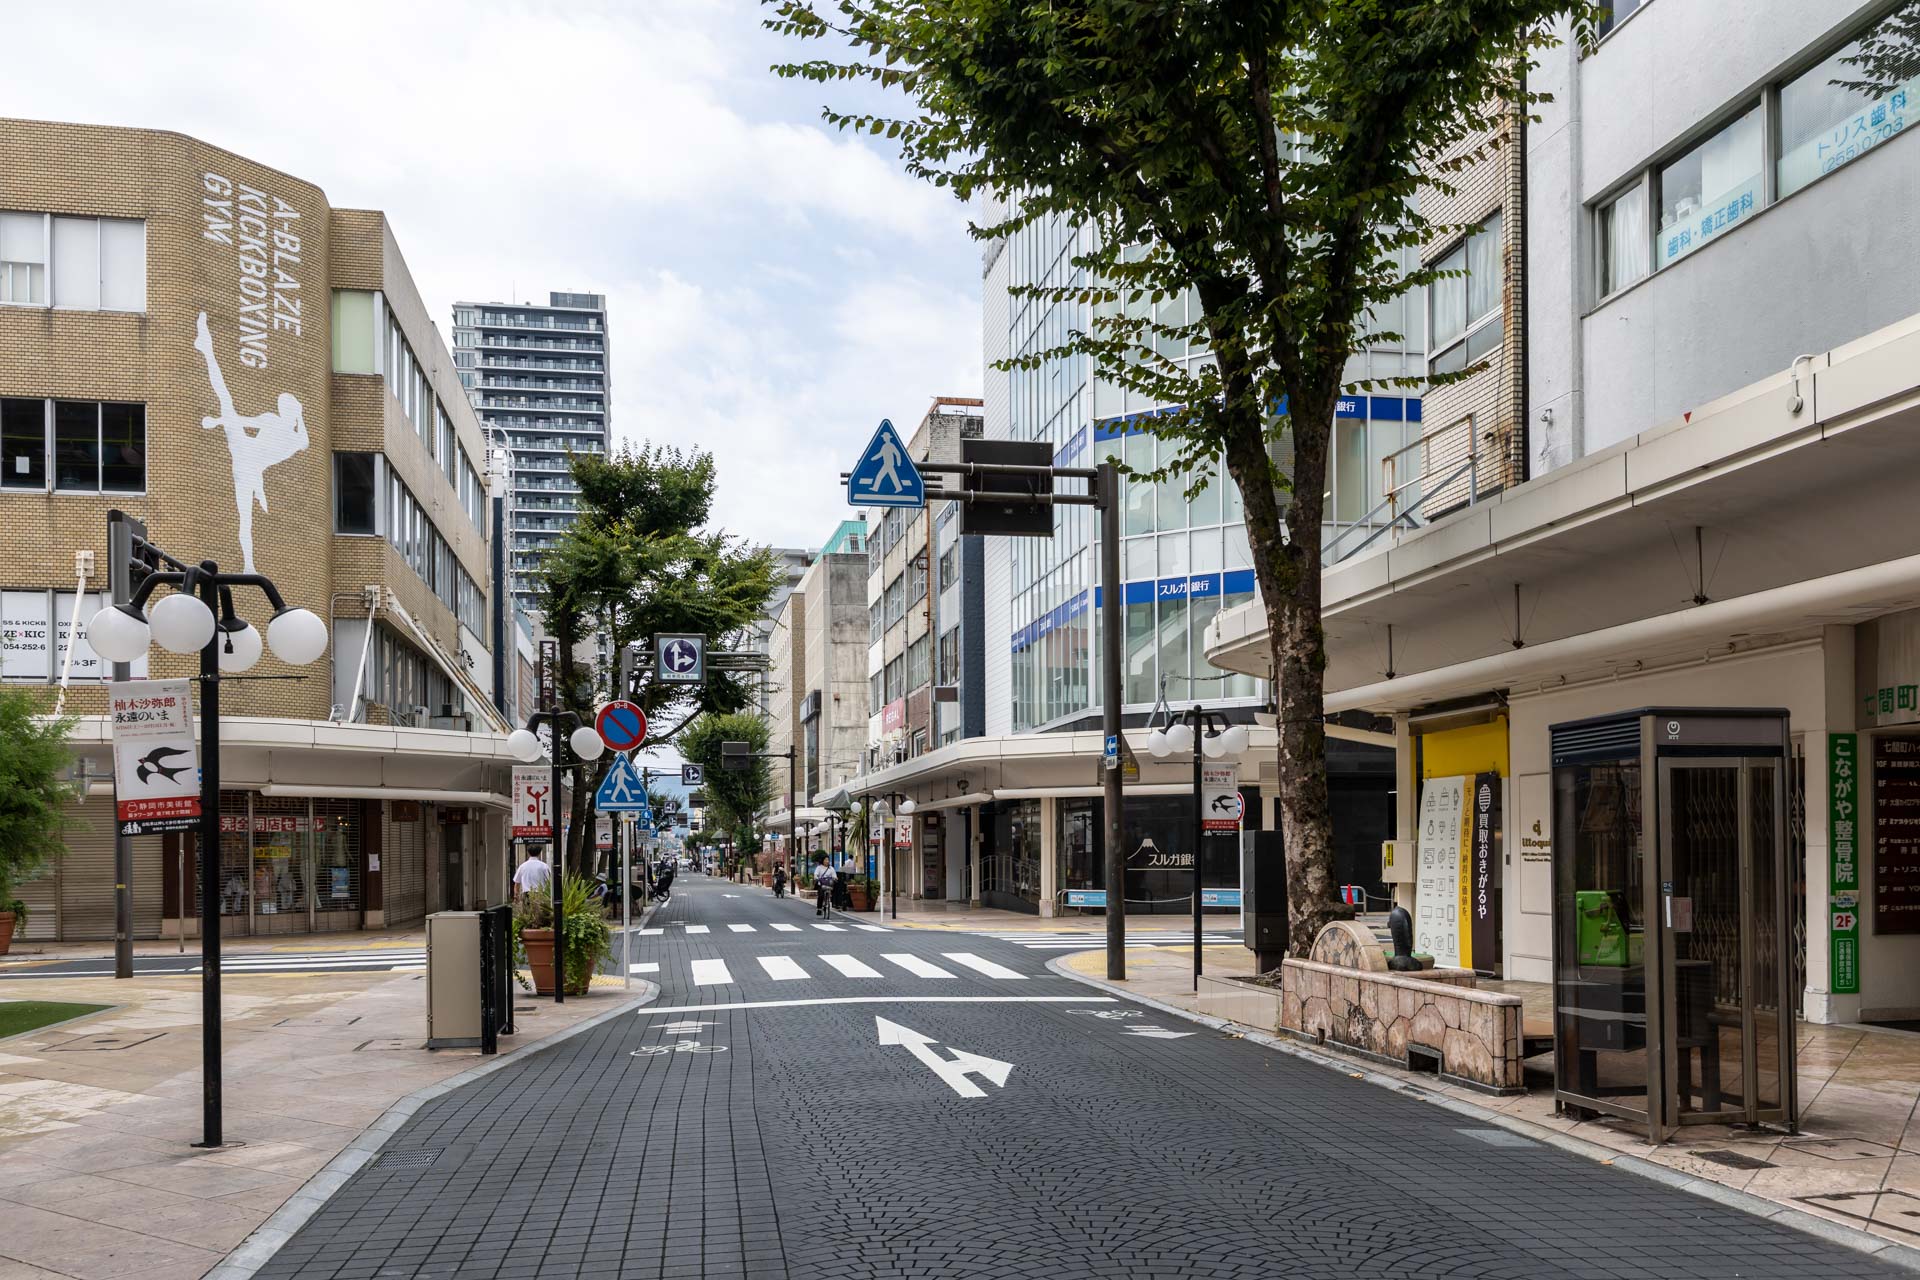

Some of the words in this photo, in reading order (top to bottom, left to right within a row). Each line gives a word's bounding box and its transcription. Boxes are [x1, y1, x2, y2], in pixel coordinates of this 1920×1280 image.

[1818, 90, 1906, 160] トリス歯科
[1822, 116, 1904, 174] (255)0703
[203, 172, 233, 246] GYM
[239, 183, 268, 369] KICKBOXING
[273, 196, 301, 337] A-BLAZE
[1159, 580, 1210, 596] スルガ銀行
[114, 696, 176, 712] 柚木沙弥郎
[115, 709, 170, 724] 永遠のいま
[640, 818, 649, 829] P
[1834, 738, 1854, 884] こながや整骨院
[650, 830, 657, 838] P
[1476, 813, 1490, 919] 買取おきがるや
[1893, 865, 1920, 873] トリス
[1835, 914, 1852, 928] 2F
